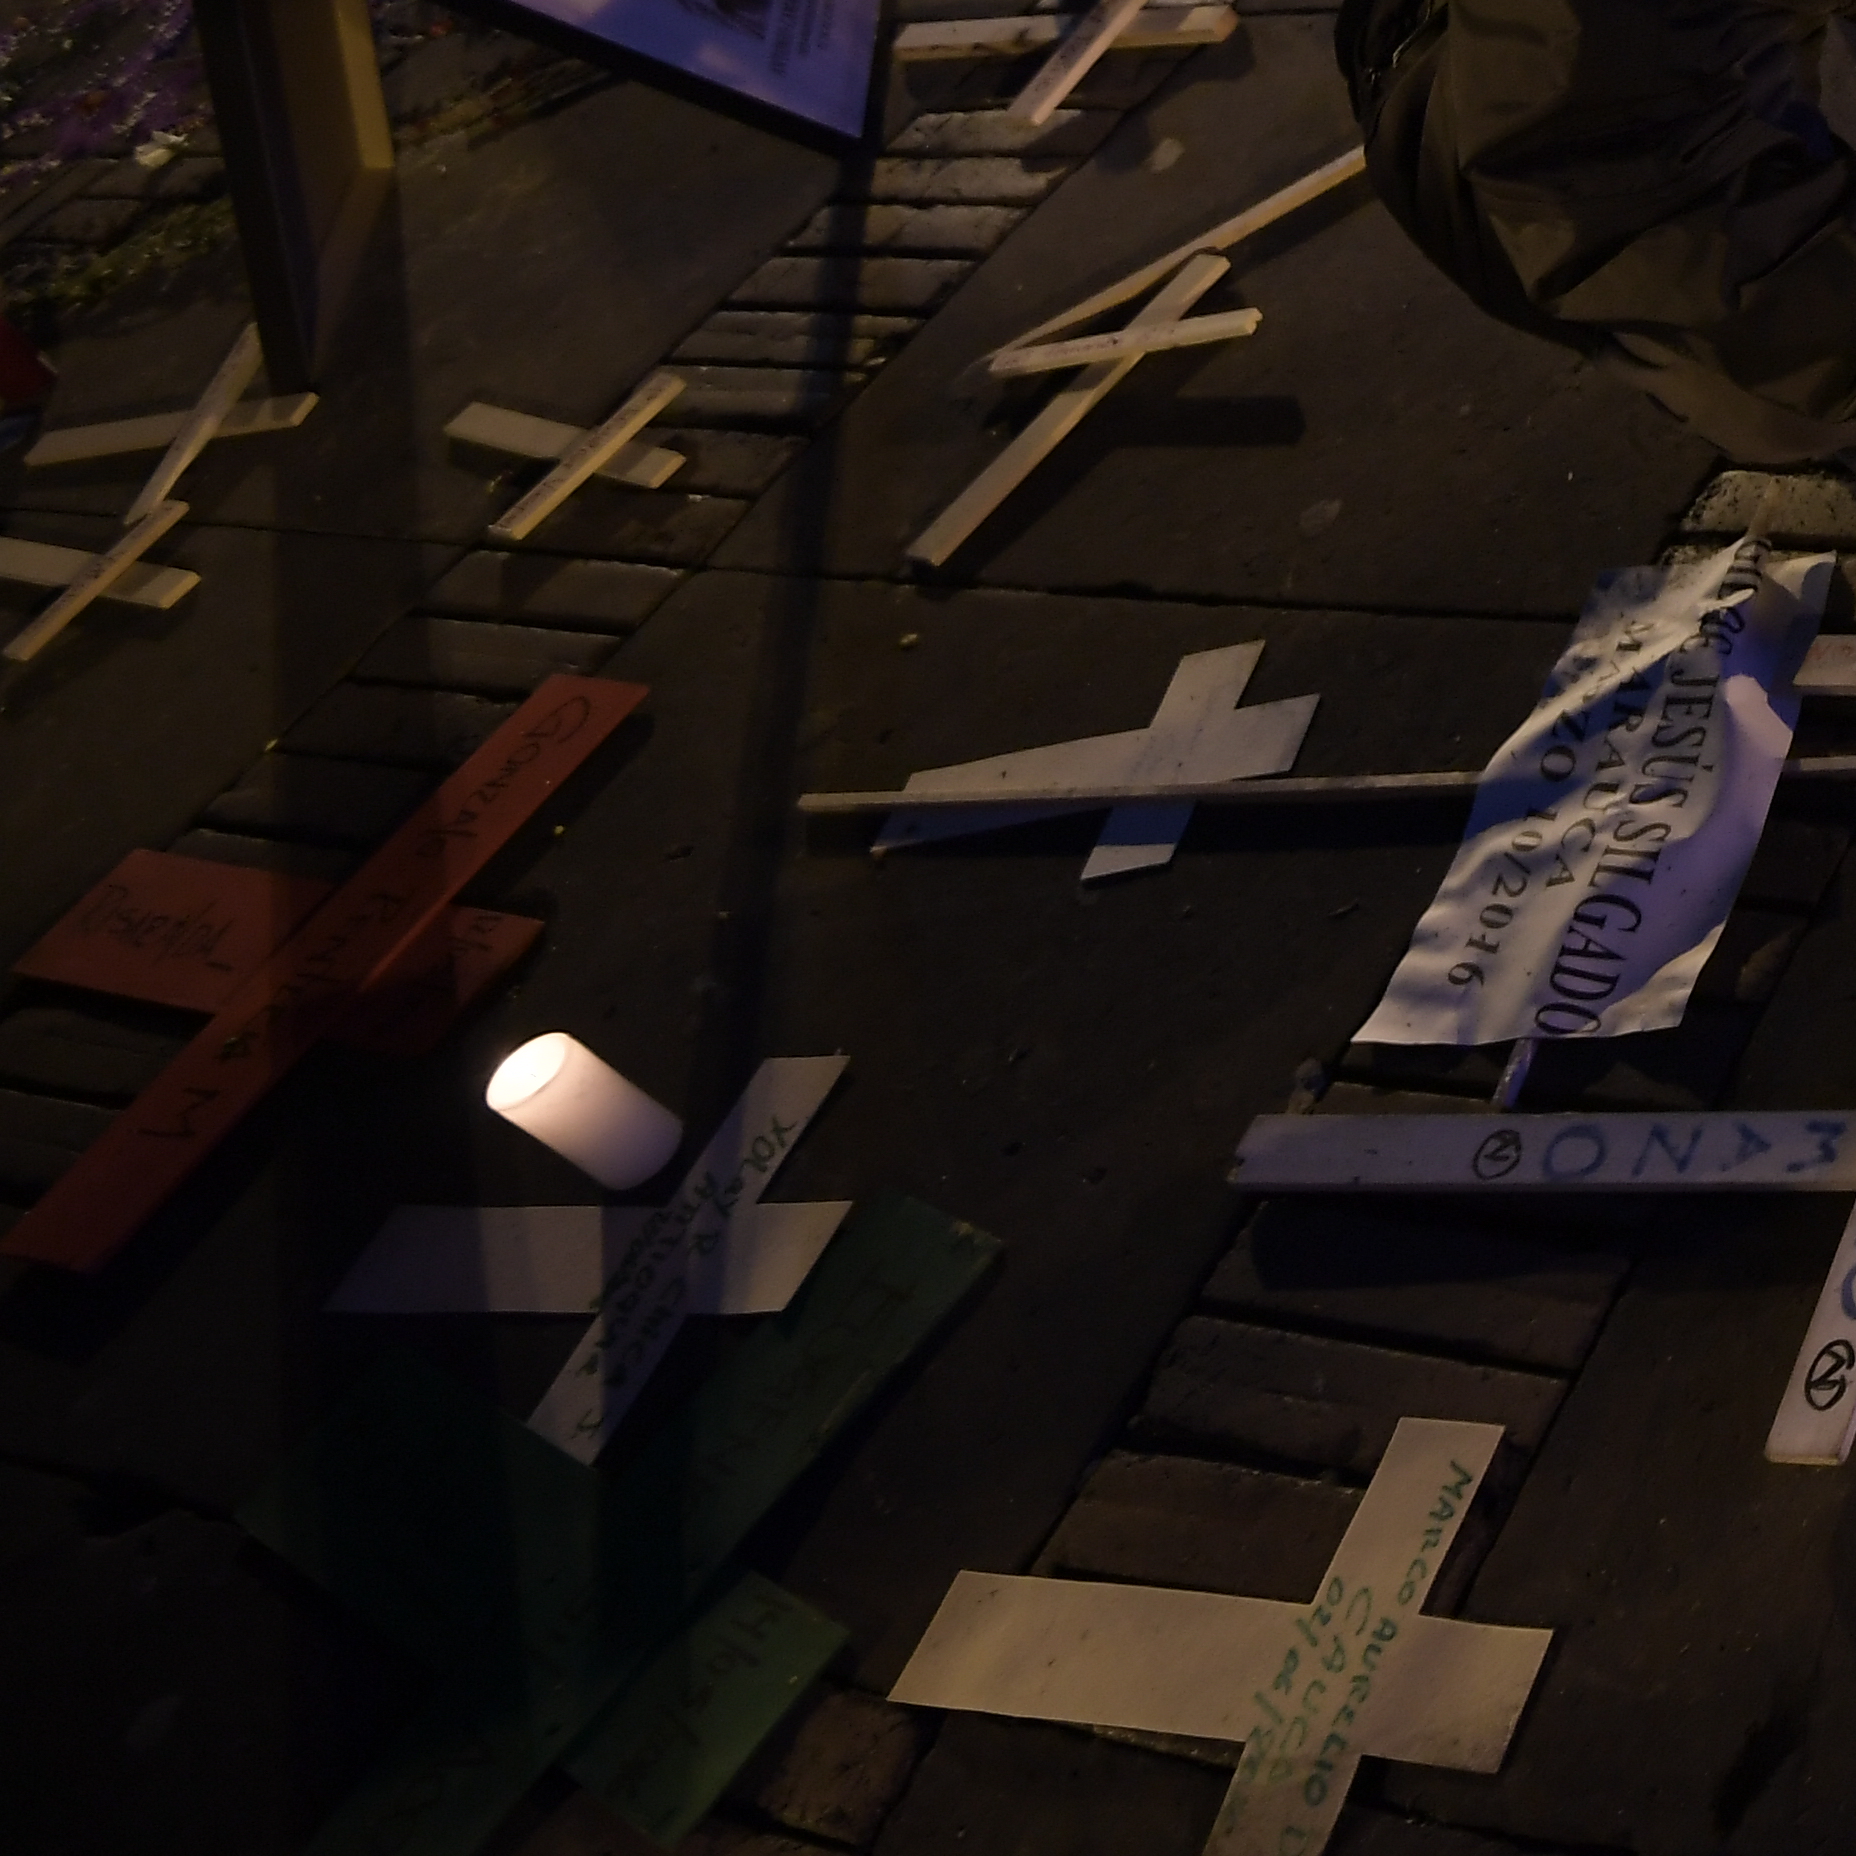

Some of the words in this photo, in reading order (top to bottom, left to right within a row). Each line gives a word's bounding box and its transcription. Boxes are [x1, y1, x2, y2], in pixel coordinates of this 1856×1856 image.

[1534, 808, 1667, 1037] SILGADO
[1544, 1118, 1845, 1185] MAZO
[1394, 1461, 1471, 1603] MARCO
[1301, 1615, 1398, 1808] AURELIO
